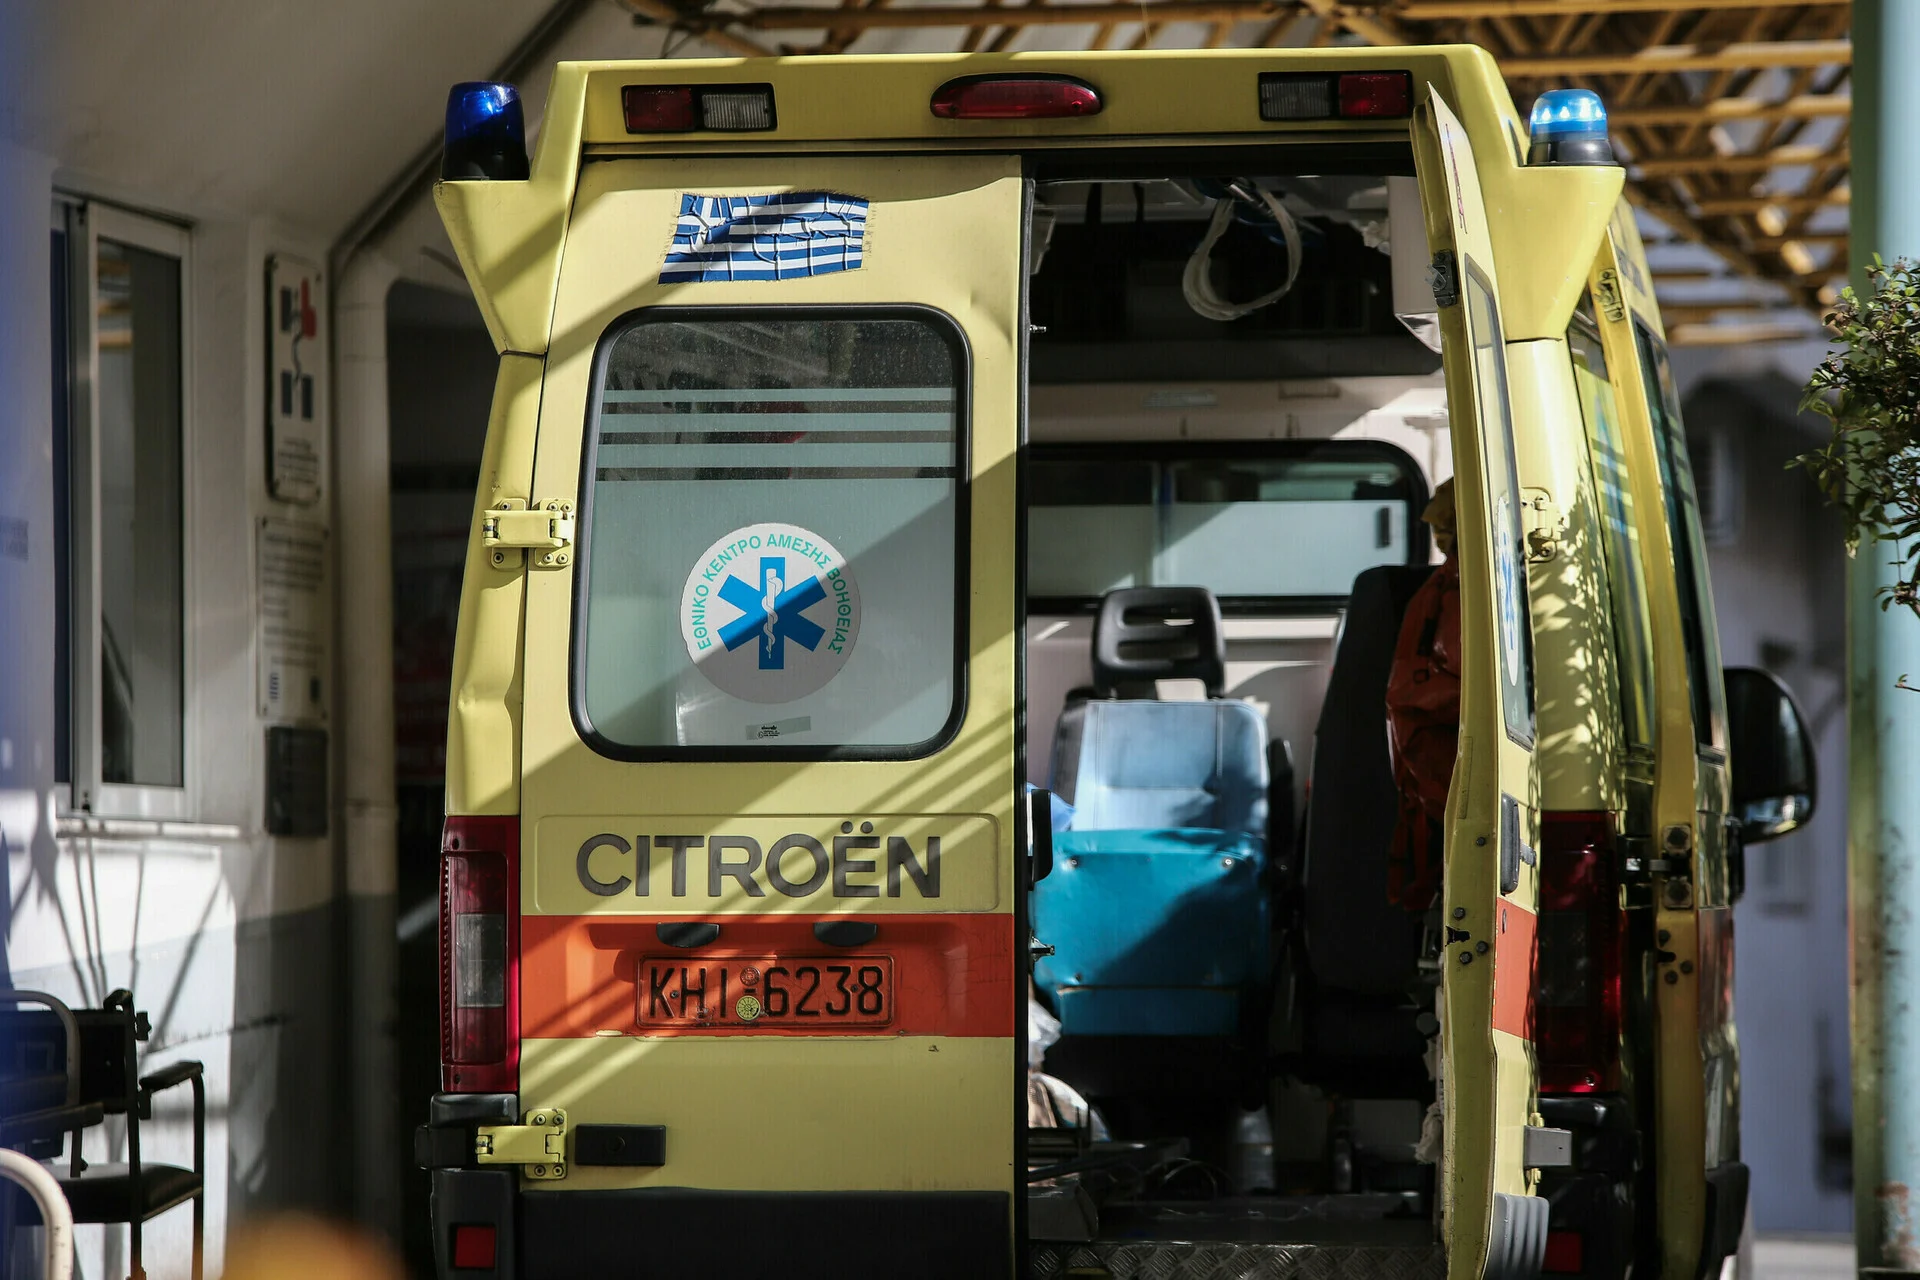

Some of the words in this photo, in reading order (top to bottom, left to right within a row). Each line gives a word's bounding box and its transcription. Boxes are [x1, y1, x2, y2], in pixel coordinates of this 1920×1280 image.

[691, 584, 712, 651] ΕΘΝΙΚΟ
[702, 535, 761, 582] ΚΕΝΤΡΟ
[766, 533, 831, 569] ΑΜΕΣΗΣ
[826, 566, 852, 655] ΒΟΗΘΕΙΑΣ
[576, 821, 940, 898] CITROËN
